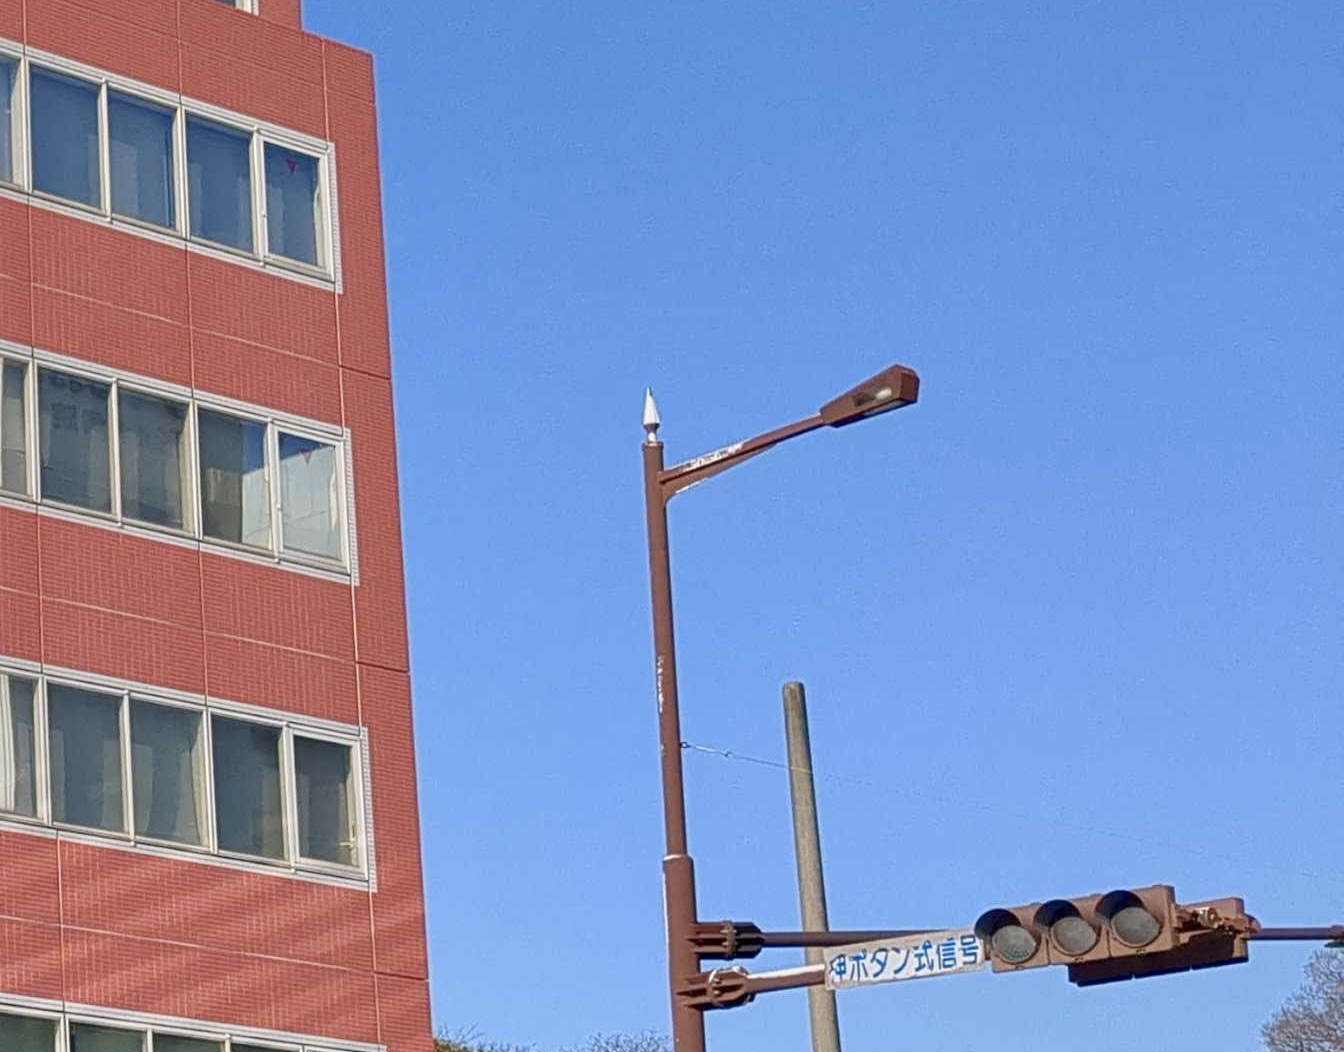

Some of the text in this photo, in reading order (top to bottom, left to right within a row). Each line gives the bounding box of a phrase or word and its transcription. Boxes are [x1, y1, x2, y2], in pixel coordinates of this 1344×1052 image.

[829, 934, 979, 982] 押ボタン式信号
